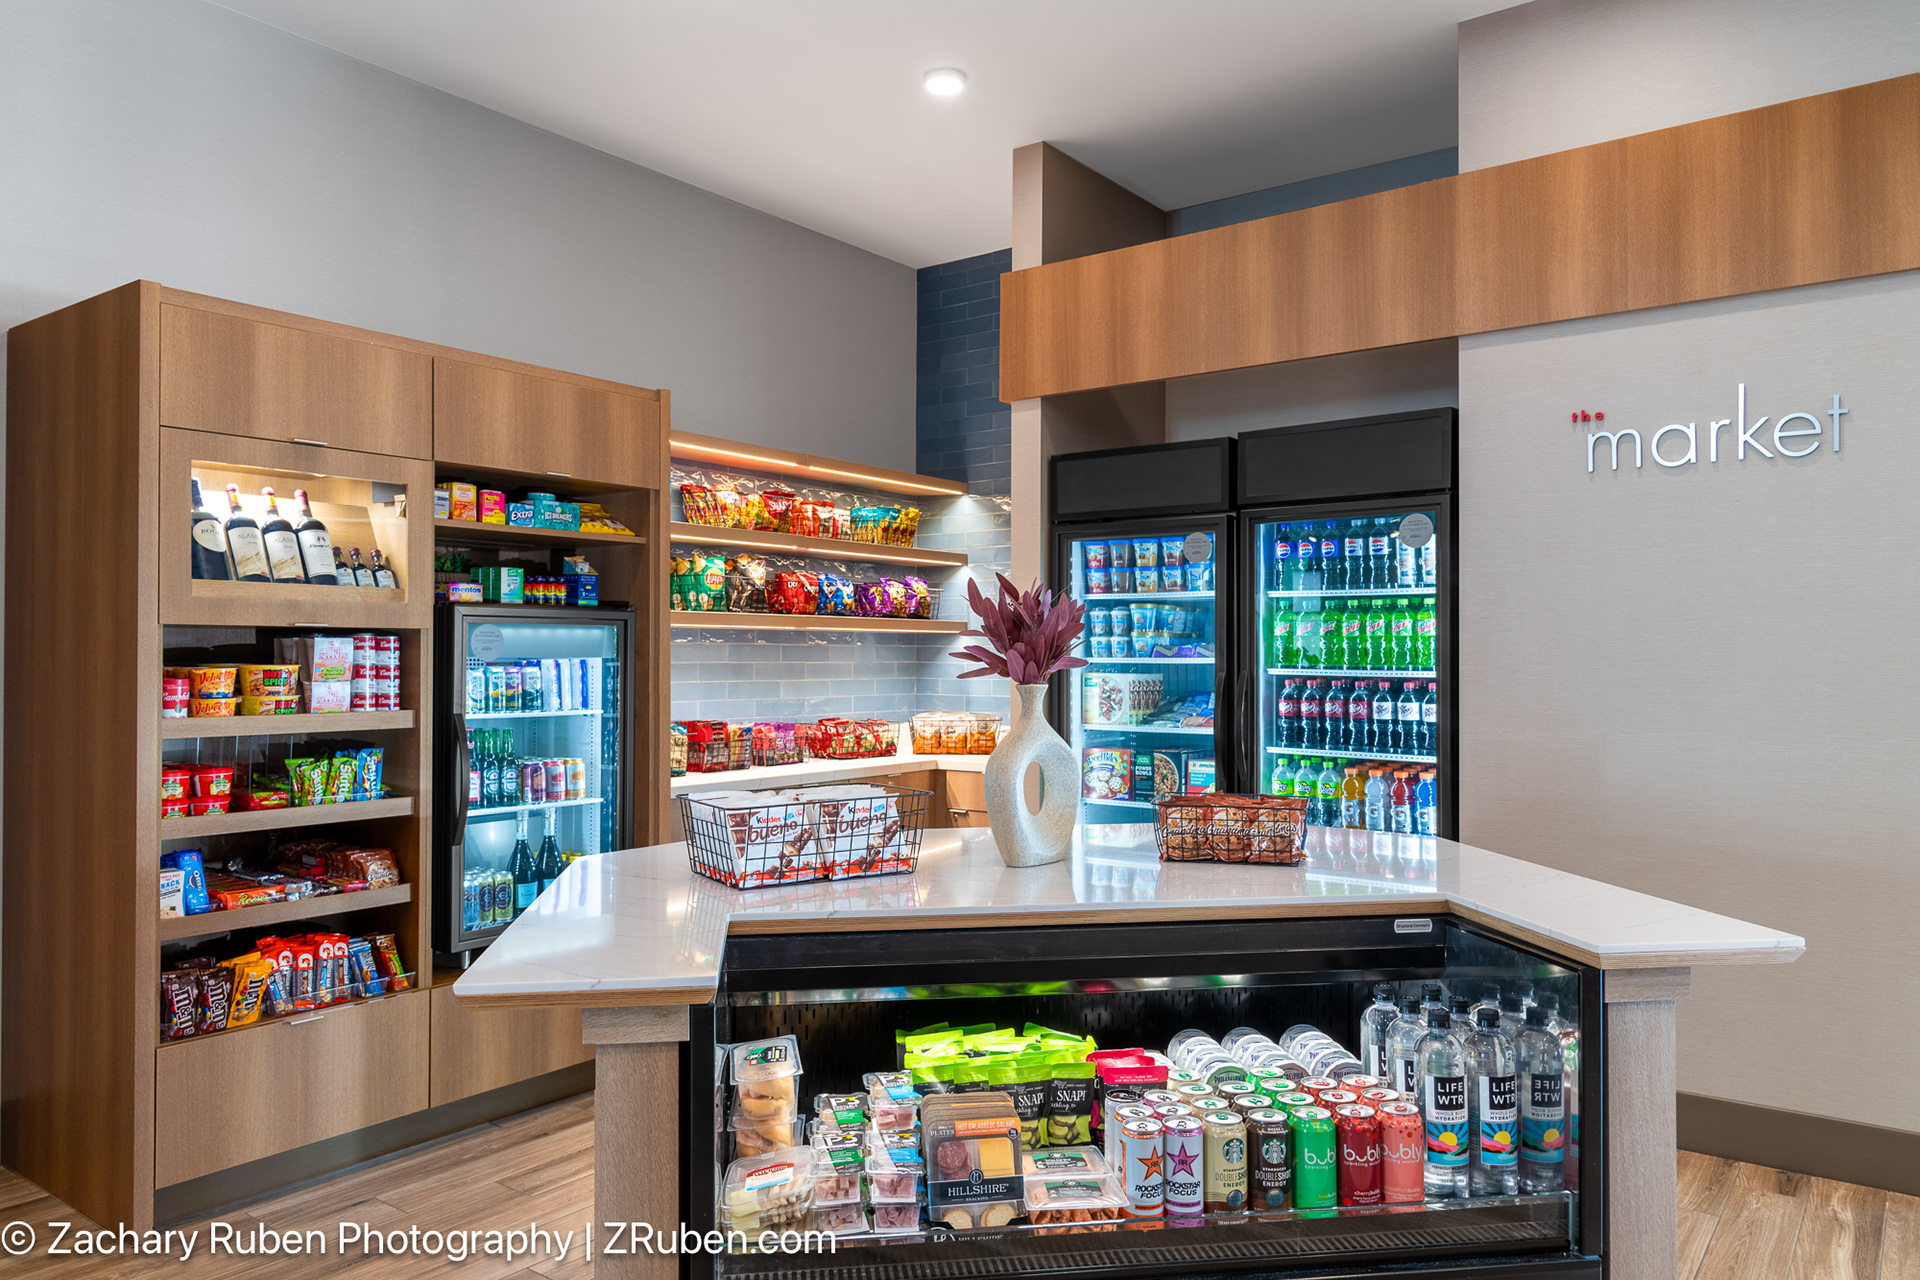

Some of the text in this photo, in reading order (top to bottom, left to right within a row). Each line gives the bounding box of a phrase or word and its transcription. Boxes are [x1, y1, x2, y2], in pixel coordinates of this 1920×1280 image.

[1571, 409, 1605, 423] the
[1587, 383, 1849, 473] market
[511, 510, 533, 521] Extra
[544, 511, 553, 520] ICE
[451, 586, 482, 594] mentos
[263, 678, 288, 686] SPICY
[755, 815, 782, 824] kinder
[838, 811, 887, 834] bueno
[748, 820, 798, 843] bueno
[160, 880, 180, 889] NACK
[1214, 1074, 1246, 1083] PHILADELPHIA
[1437, 1081, 1464, 1092] LIFE
[1492, 1080, 1515, 1092] LIFE
[1018, 1092, 1044, 1107] SNAP!
[1056, 1089, 1085, 1102] SNAP!
[1437, 1095, 1464, 1105] WTR
[1492, 1094, 1516, 1105] WTR
[829, 1096, 860, 1106] P3
[957, 1123, 968, 1131] HOT
[968, 1121, 996, 1130] CALABRESE
[930, 1129, 955, 1137] PLATES
[824, 1134, 859, 1145] P3
[1343, 1160, 1368, 1168] sparkling
[947, 1183, 1007, 1197] HILLSHIRE
[1169, 1187, 1197, 1196] FOCUS
